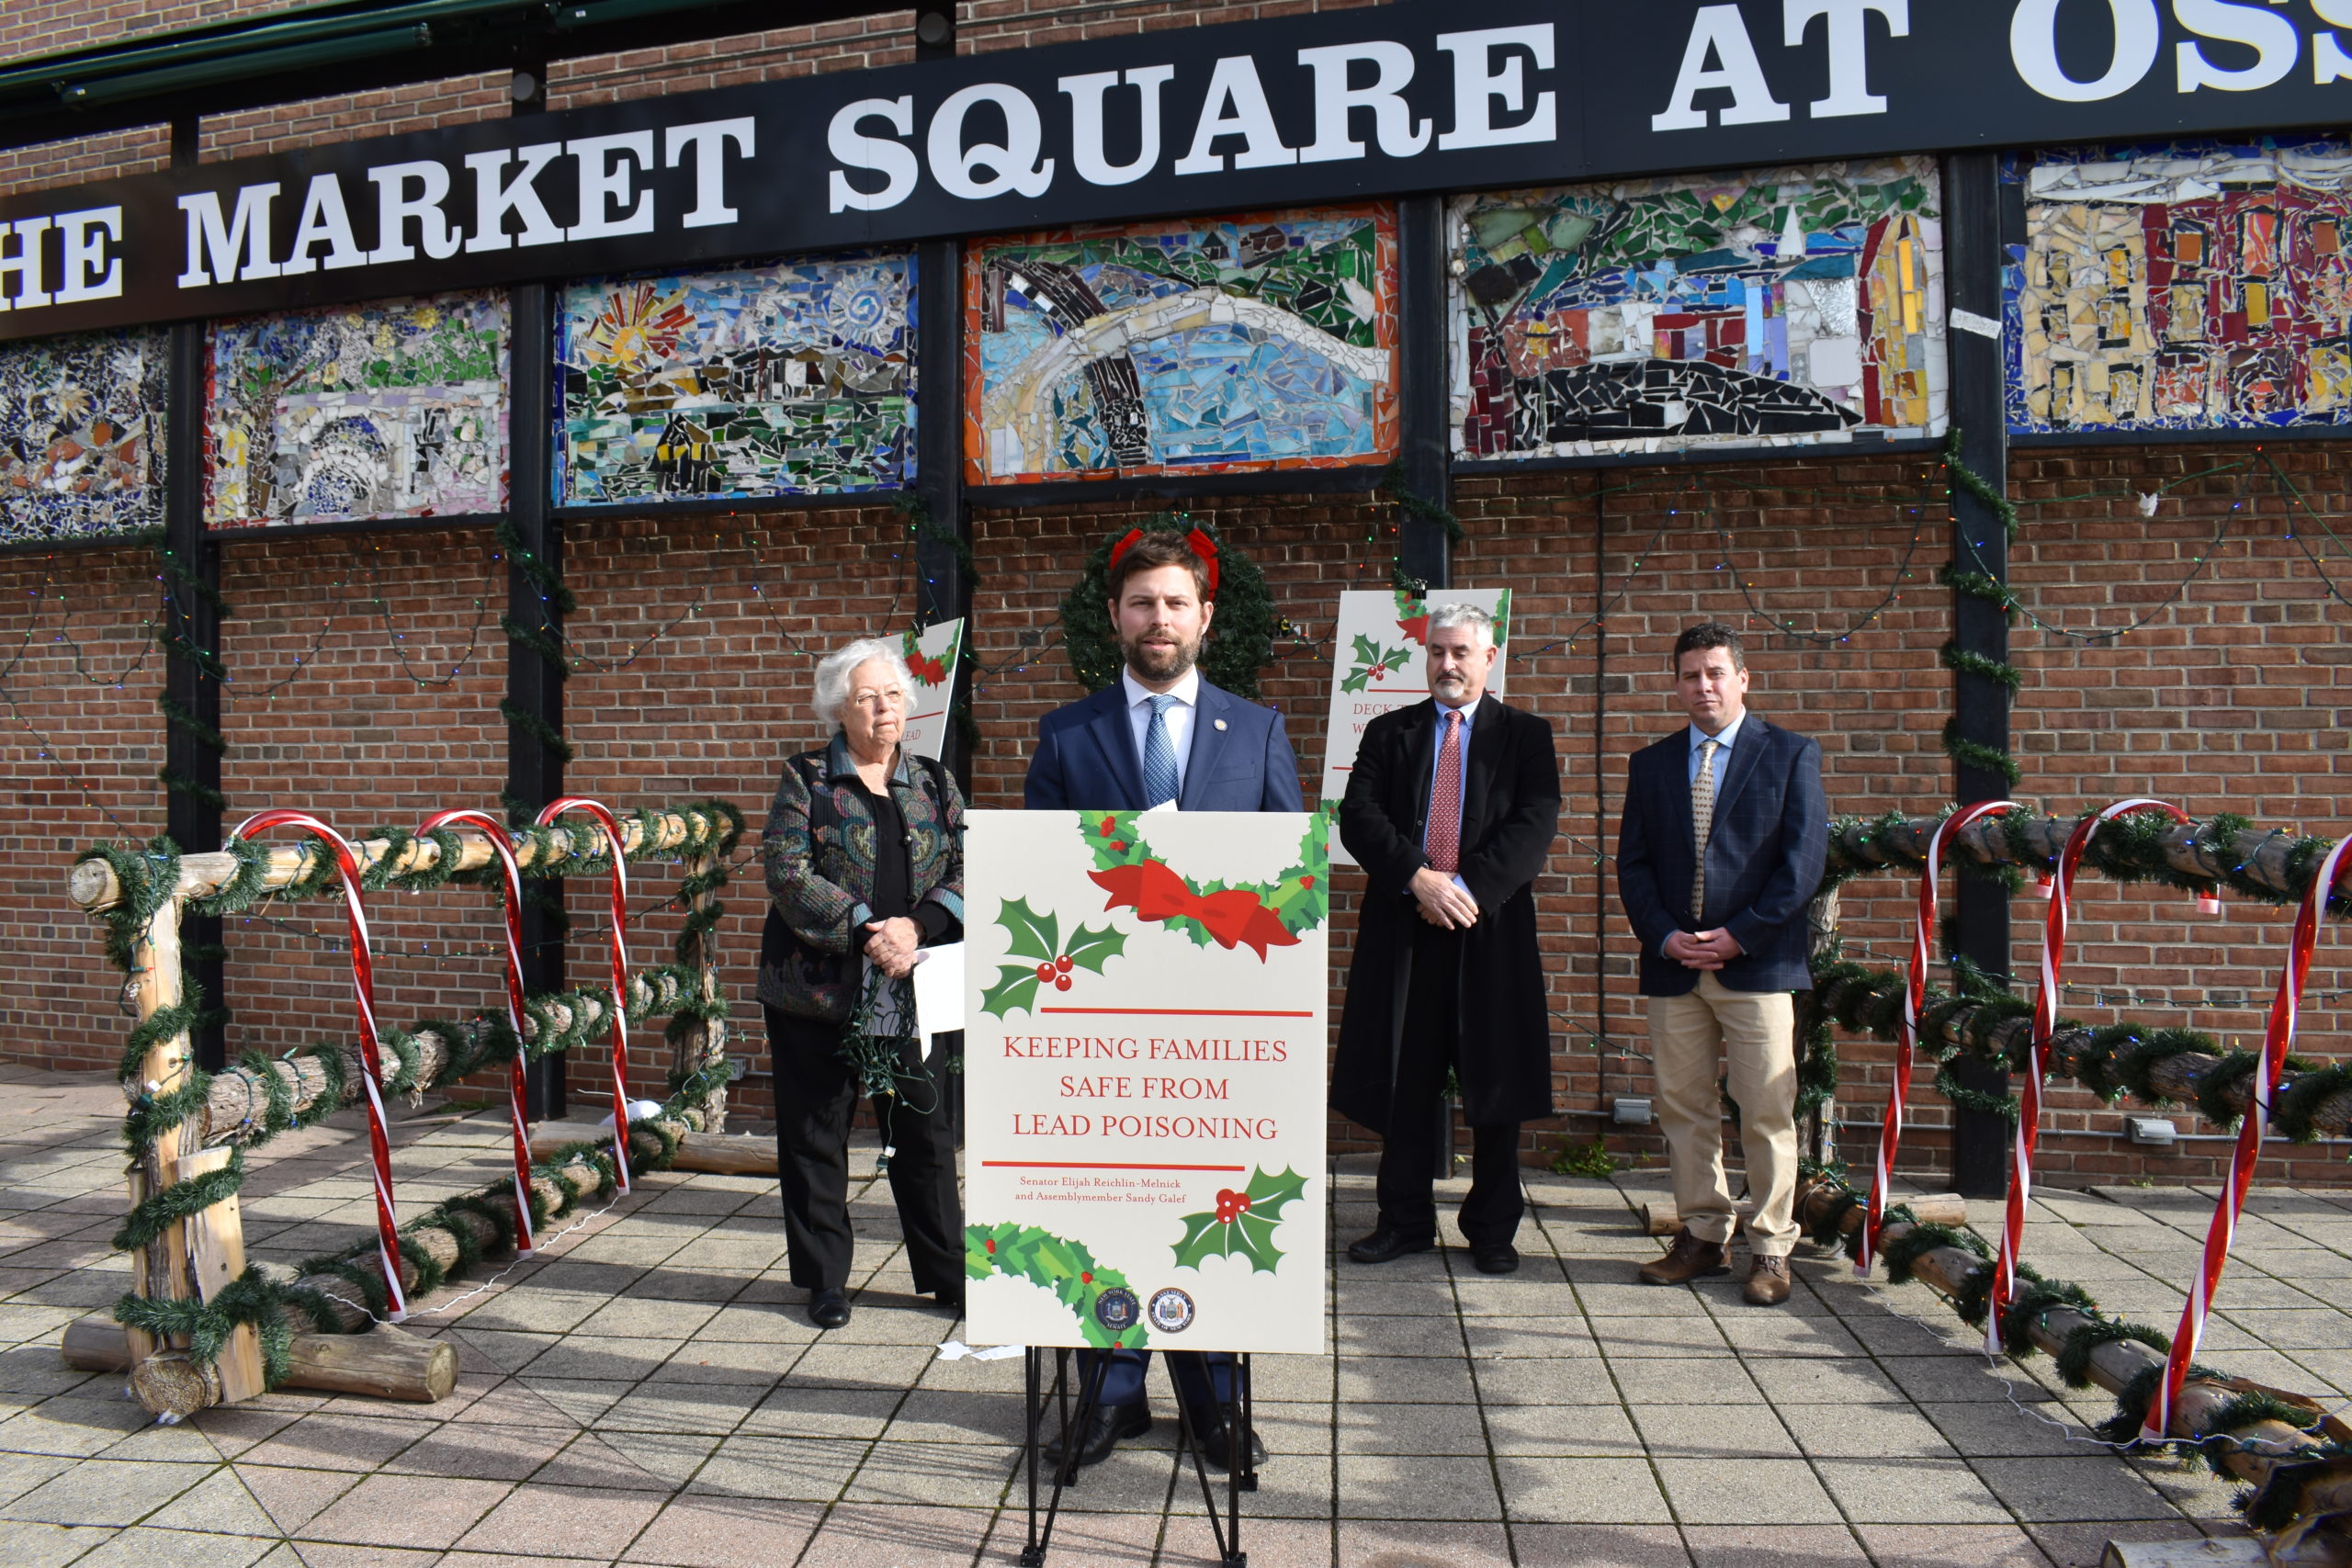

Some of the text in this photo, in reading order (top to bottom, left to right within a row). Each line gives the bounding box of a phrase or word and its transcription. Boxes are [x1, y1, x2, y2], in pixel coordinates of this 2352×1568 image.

[178, 116, 756, 288] MARKET
[828, 23, 1556, 214] SQUARE
[1651, 0, 1909, 132] AT
[1353, 703, 1393, 716] DECK
[1001, 1035, 1288, 1063] KEEPING FAMILIES
[1059, 1075, 1229, 1100] SAFE FROM
[1012, 1113, 1280, 1140] LEAD POISONING
[1020, 1176, 1182, 1190] Senator Elijah Reichlin-Melnick
[1014, 1191, 1187, 1206] and Assemblymember Sandy Galef
